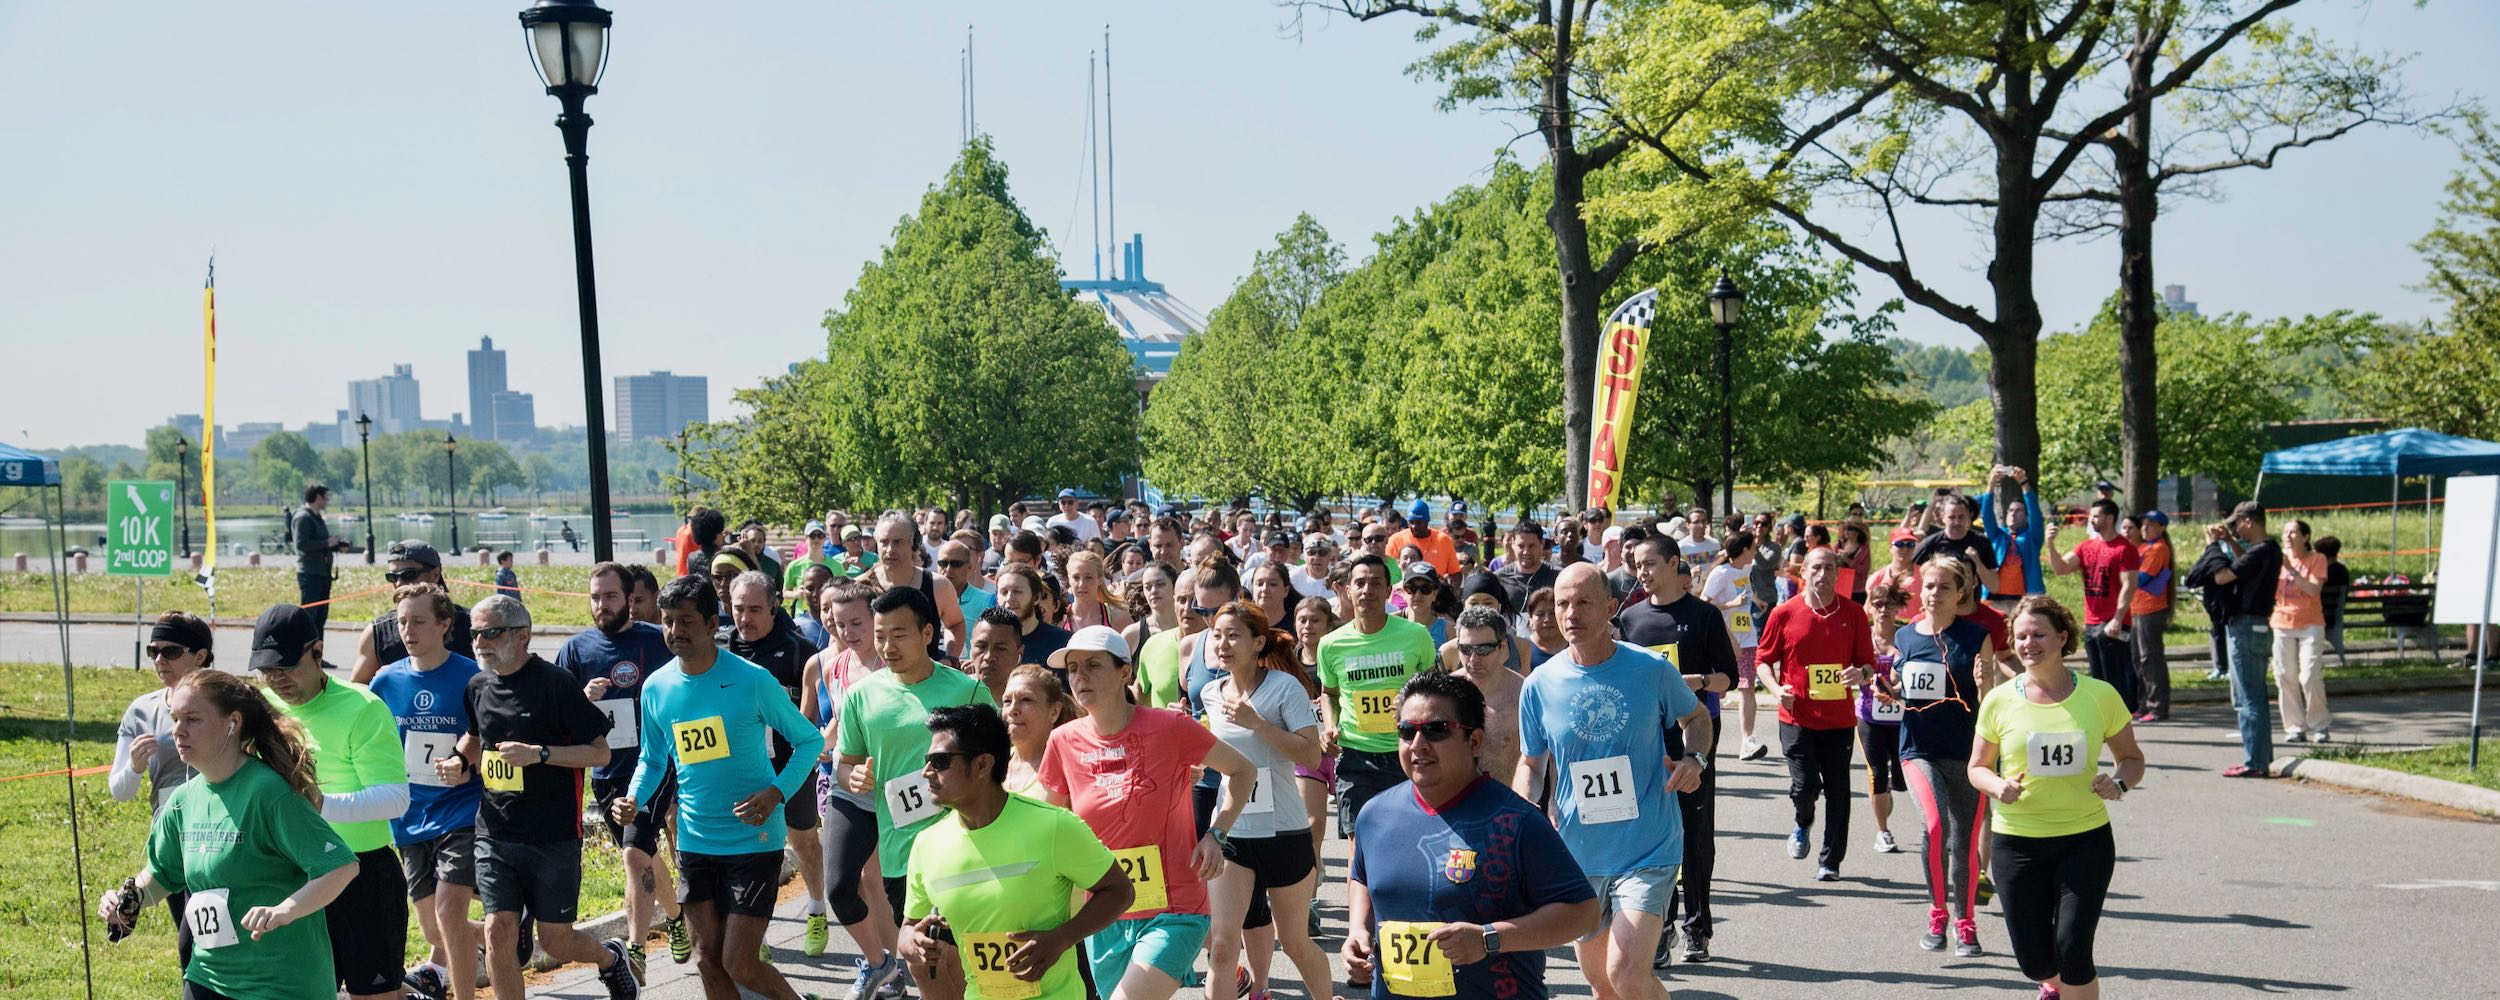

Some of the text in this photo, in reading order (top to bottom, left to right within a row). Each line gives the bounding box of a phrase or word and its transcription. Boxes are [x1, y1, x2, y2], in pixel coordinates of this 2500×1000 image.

[1348, 664, 1404, 682] NUTRITION
[1910, 672, 1934, 690] 162
[1362, 696, 1392, 714] 519
[1570, 684, 1624, 706] SRI CHINMOY
[395, 716, 457, 726] BROOKSTONE
[1570, 712, 1630, 742] MARATHON TEAM
[681, 726, 717, 752] 520
[424, 744, 434, 764] 7
[2041, 744, 2074, 766] 143
[488, 760, 514, 780] 800
[1582, 770, 1622, 798] 211
[898, 785, 923, 813] 15
[195, 906, 220, 936] 123
[1392, 933, 1433, 965] 527
